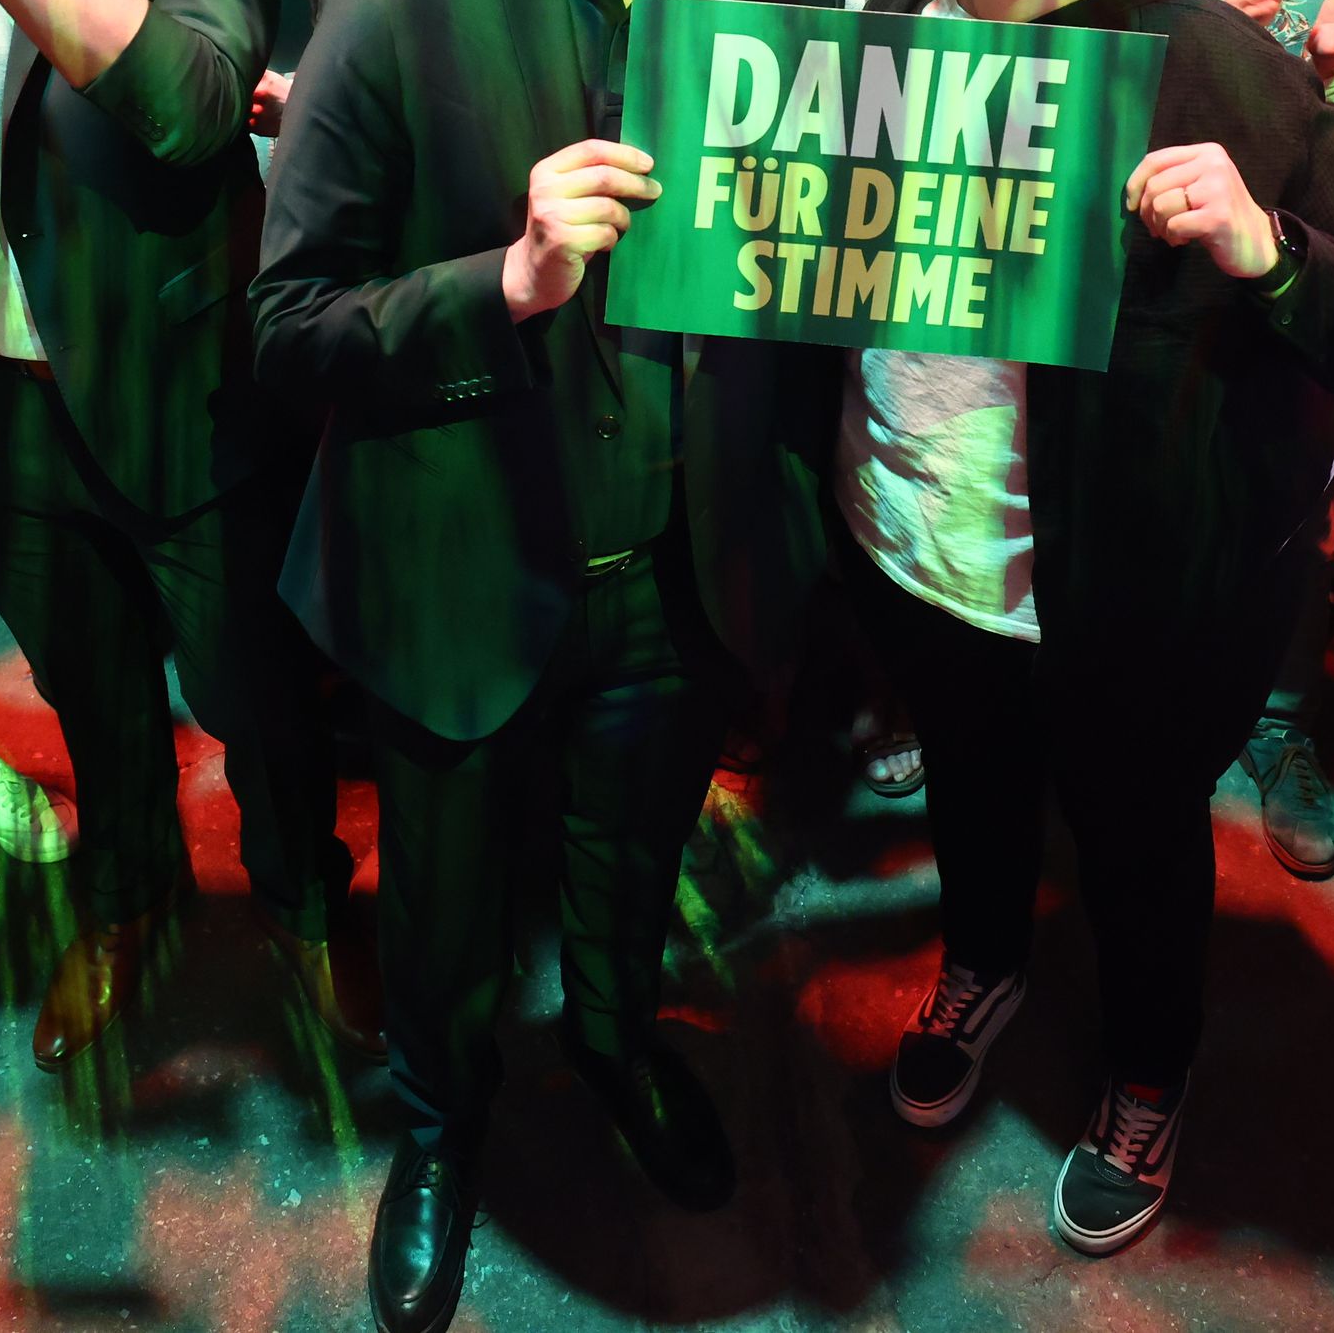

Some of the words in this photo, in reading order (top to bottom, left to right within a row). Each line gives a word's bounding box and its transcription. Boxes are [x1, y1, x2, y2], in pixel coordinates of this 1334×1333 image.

[703, 32, 1070, 173] DANKE
[694, 155, 828, 236] FÜR
[843, 168, 1055, 256] DEINE
[732, 240, 993, 330] STIMME
